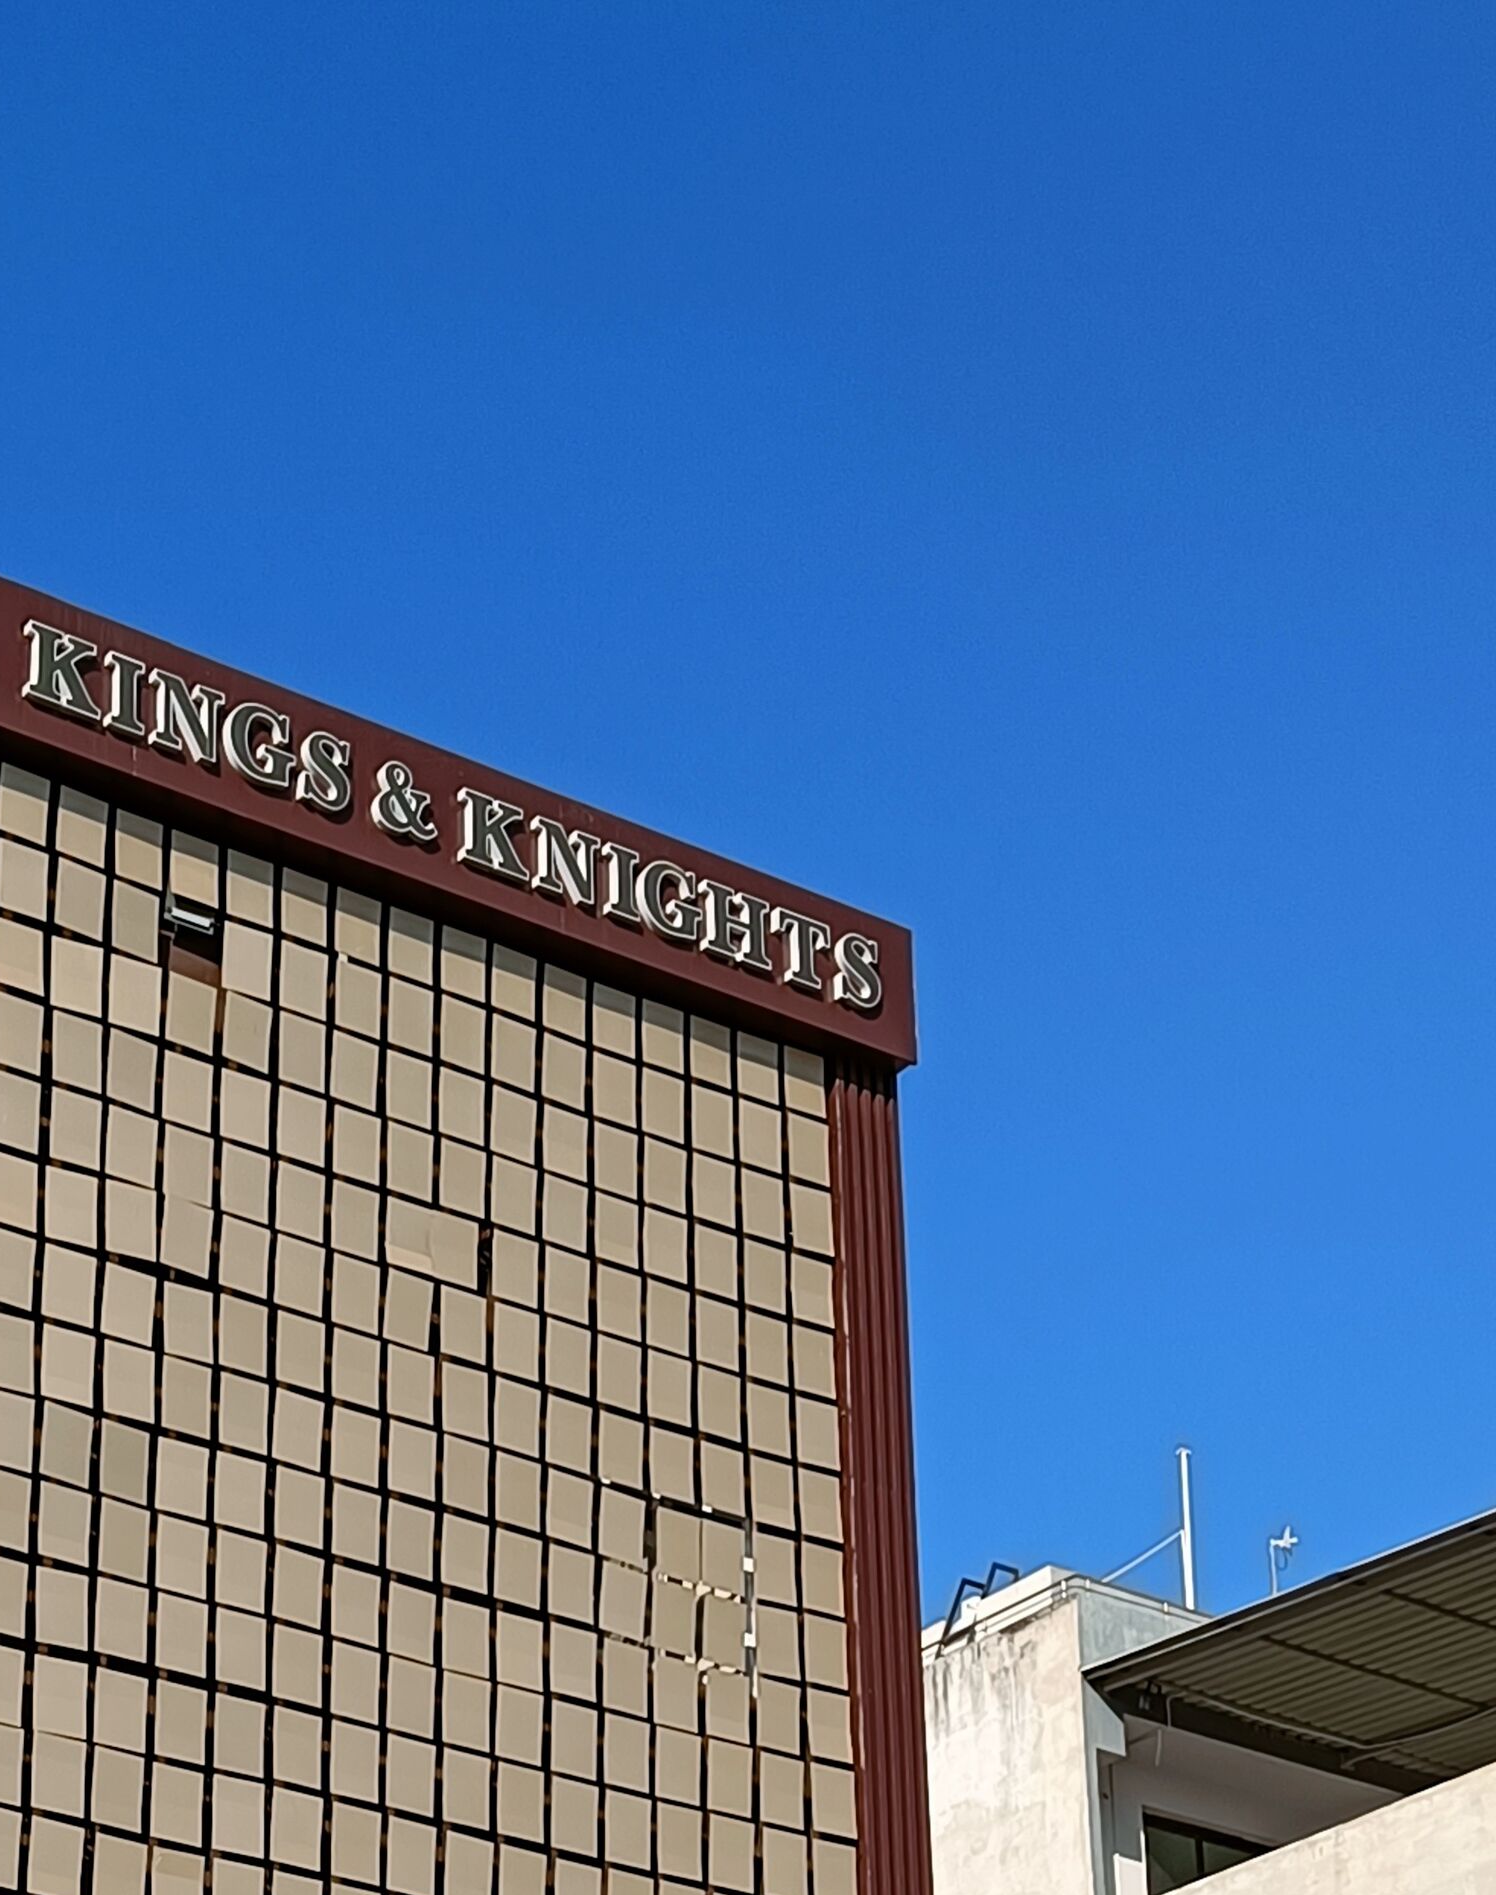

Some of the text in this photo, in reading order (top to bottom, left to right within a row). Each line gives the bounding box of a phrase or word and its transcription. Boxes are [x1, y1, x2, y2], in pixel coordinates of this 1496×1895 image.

[22, 618, 883, 1010] KINGS & KNIGHTS
